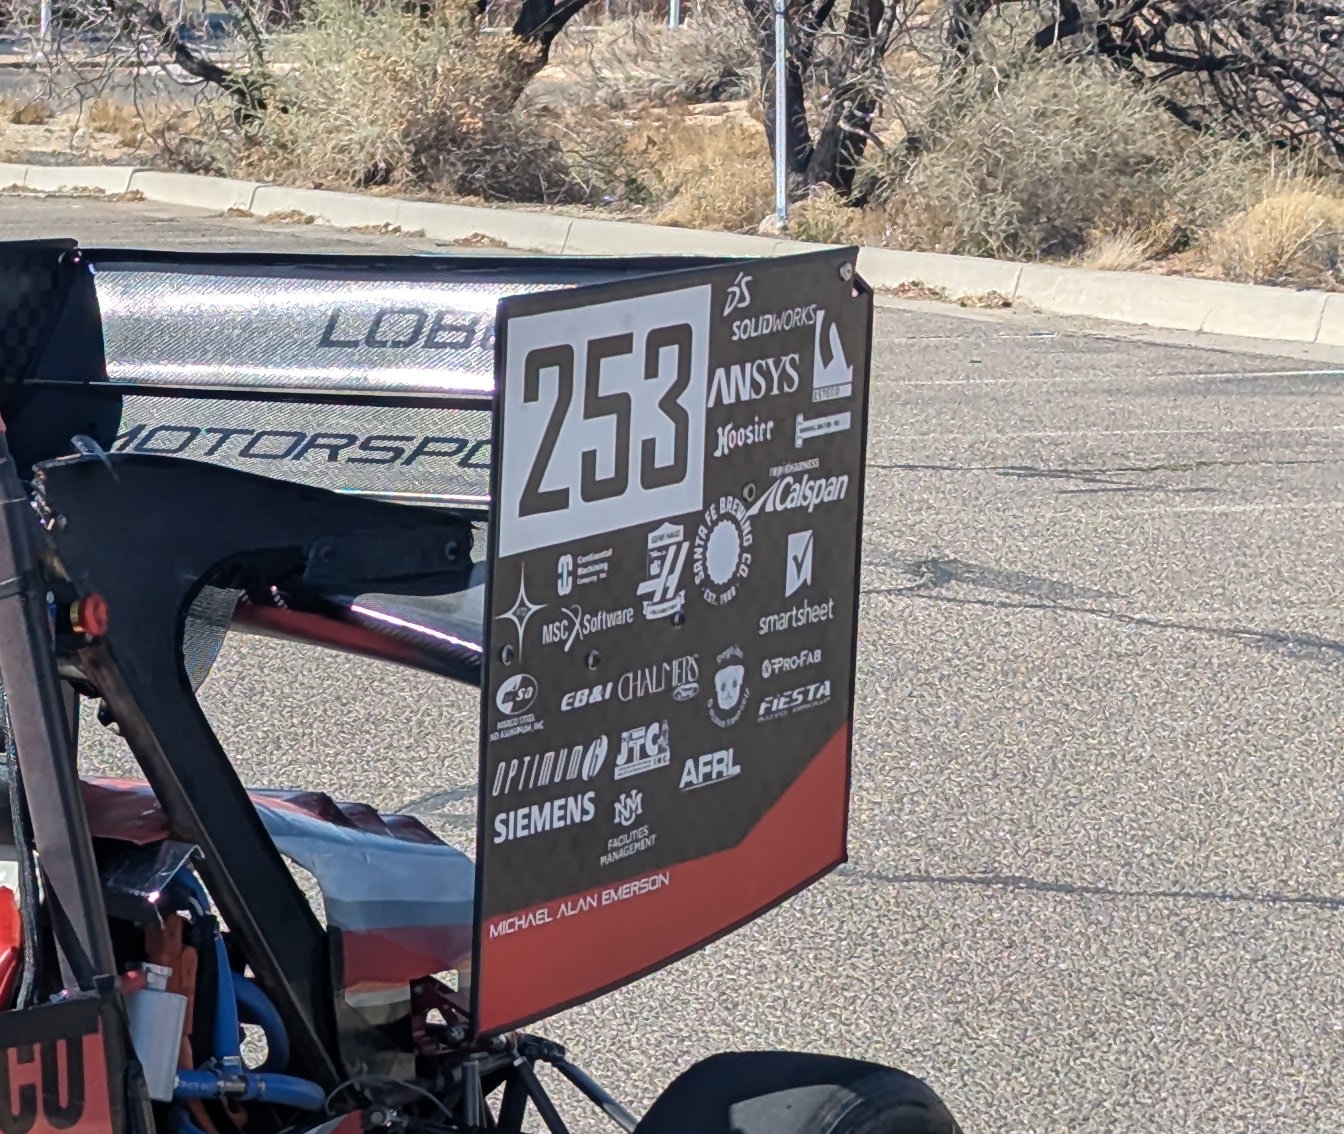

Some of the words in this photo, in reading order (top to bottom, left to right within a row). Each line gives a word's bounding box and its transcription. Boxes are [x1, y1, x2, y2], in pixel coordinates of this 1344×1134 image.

[731, 303, 817, 341] SOLIDWORKS
[708, 353, 800, 408] ANSYS
[518, 323, 693, 518] 253
[713, 415, 774, 458] Hoosier
[775, 474, 849, 515] Calspan
[693, 525, 709, 586] SANTA
[704, 502, 718, 527] FE
[719, 496, 754, 548] BREWING
[737, 551, 752, 579] CO.
[542, 618, 569, 645] MSC
[582, 606, 635, 636] Software
[759, 596, 834, 636] smartsheet
[560, 681, 614, 712] EB&I
[617, 654, 700, 702] CHALMERS
[758, 680, 831, 716] FIESTA
[678, 748, 741, 789] AFRL
[493, 790, 596, 844] SIEMENS
[607, 825, 650, 850] FACILITIES
[489, 907, 554, 938] MICHAEL
[556, 893, 598, 919] ALAN
[601, 871, 670, 906] EMERSON
